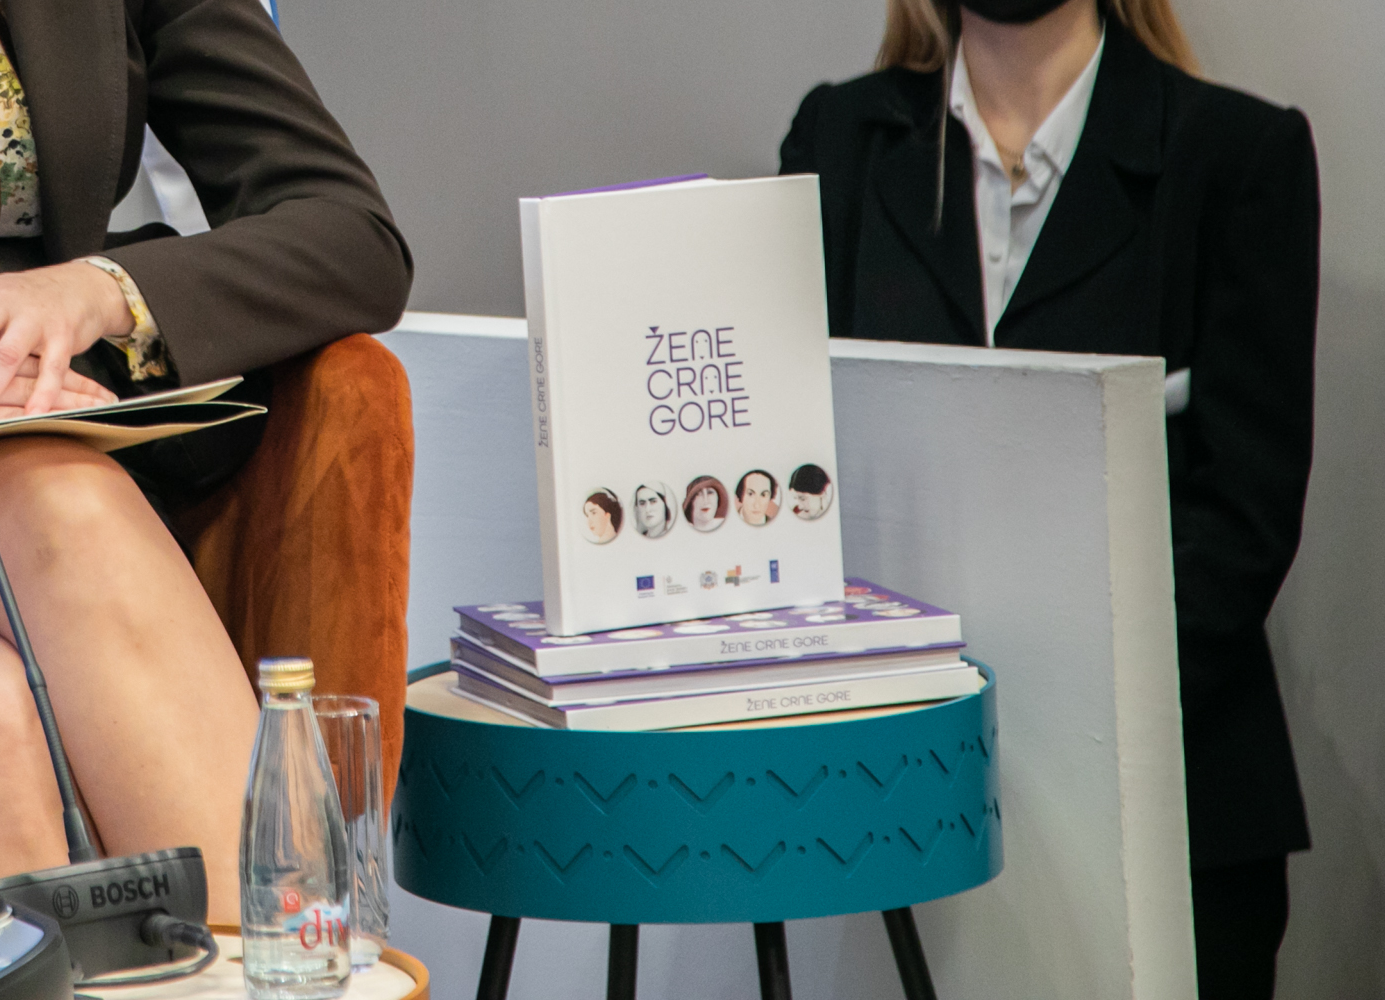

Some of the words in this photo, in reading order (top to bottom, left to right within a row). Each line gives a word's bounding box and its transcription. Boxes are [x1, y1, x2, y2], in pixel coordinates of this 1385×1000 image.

[534, 337, 545, 374] GORE
[645, 325, 736, 366] ŽENE
[647, 361, 744, 400] CRNE
[649, 396, 751, 436] GORE
[793, 635, 829, 648] GORE
[816, 690, 851, 704] GORE
[90, 874, 170, 909] BOSCH
